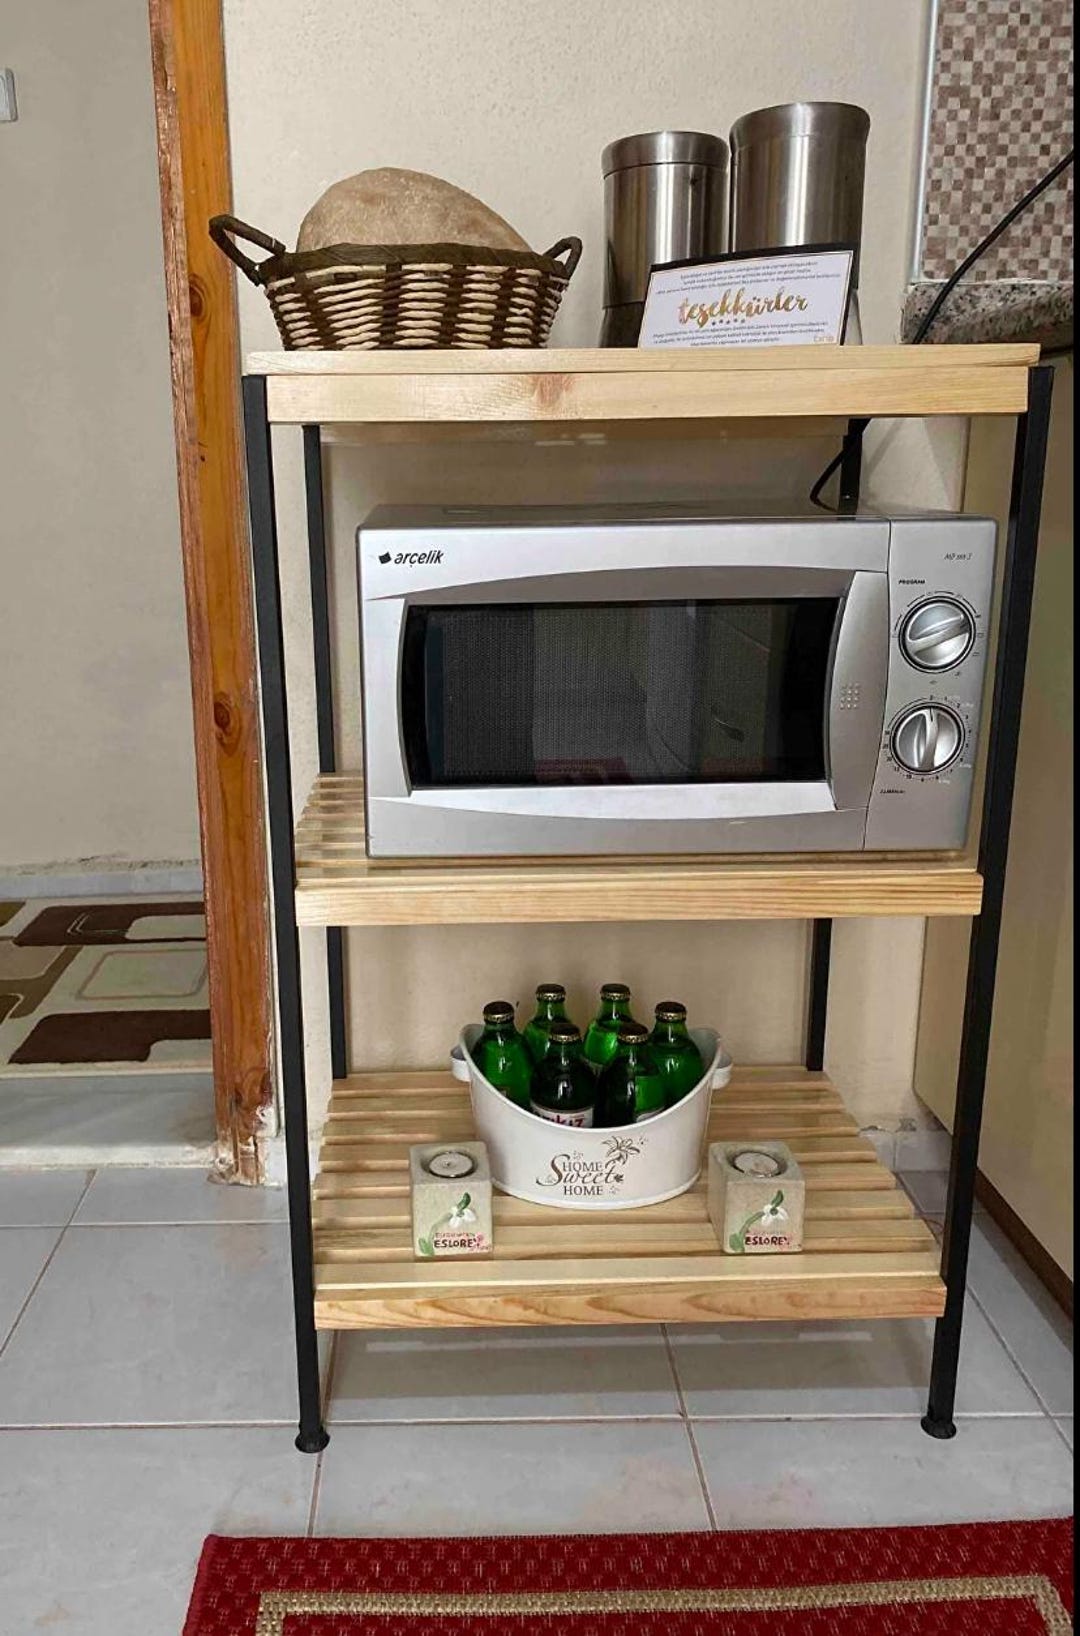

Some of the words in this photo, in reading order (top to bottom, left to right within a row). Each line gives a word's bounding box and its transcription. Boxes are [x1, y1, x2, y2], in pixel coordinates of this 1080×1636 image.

[394, 549, 444, 568] arçelik
[536, 1153, 616, 1187] Sweet
[563, 1161, 603, 1172] HOME
[563, 1185, 604, 1196] HOME
